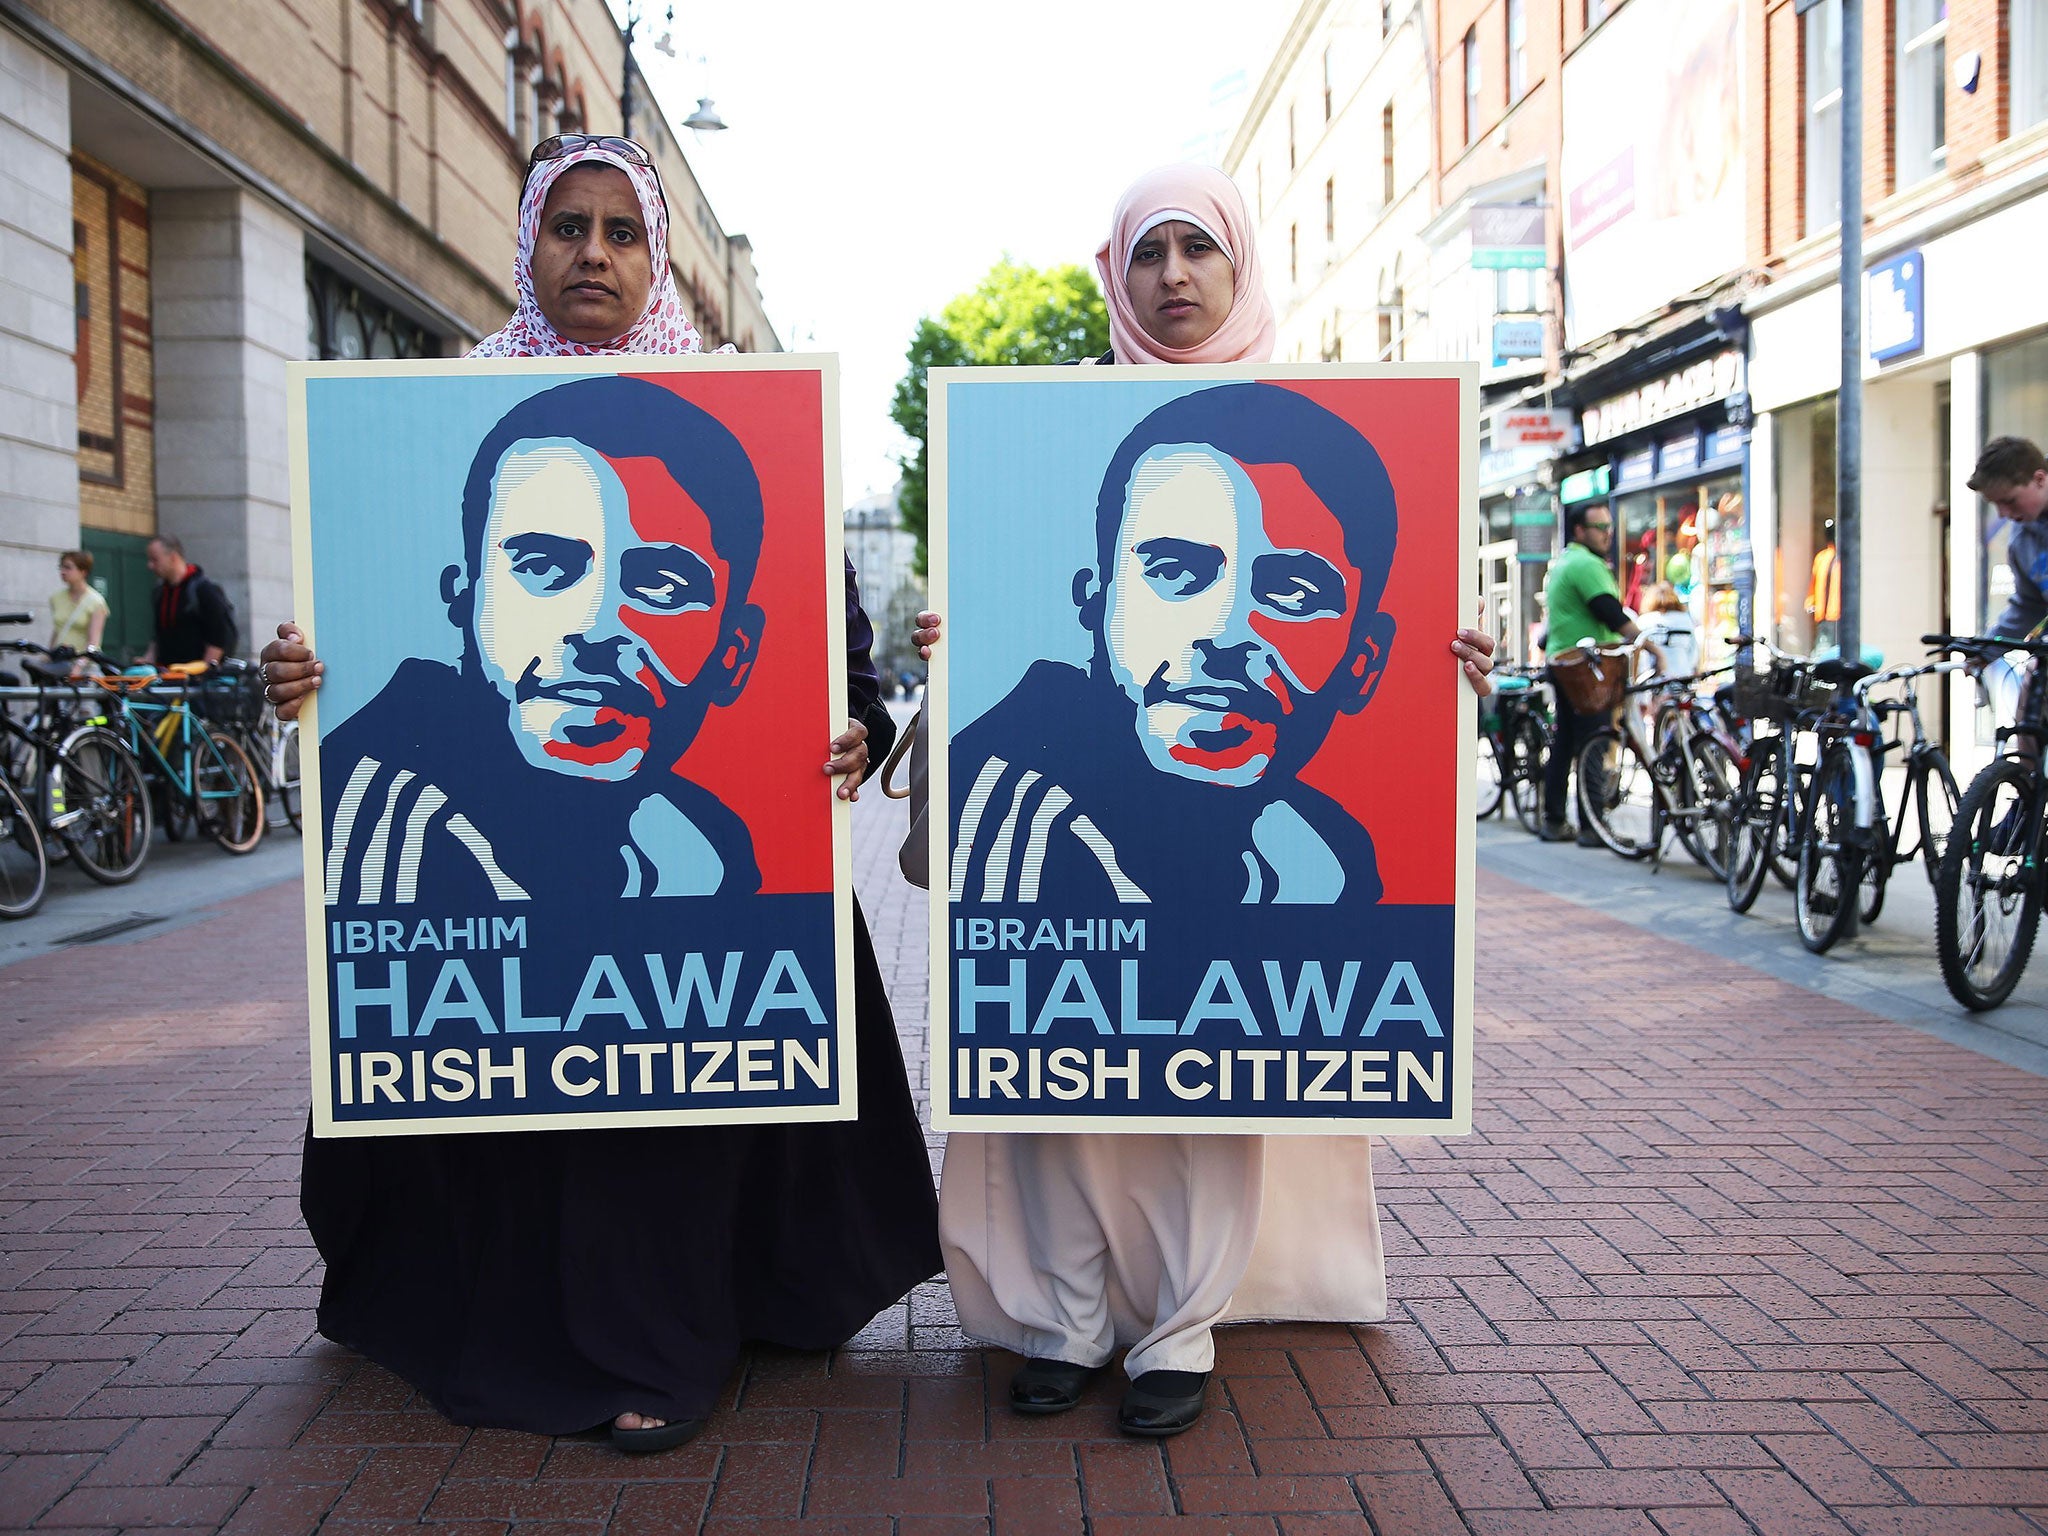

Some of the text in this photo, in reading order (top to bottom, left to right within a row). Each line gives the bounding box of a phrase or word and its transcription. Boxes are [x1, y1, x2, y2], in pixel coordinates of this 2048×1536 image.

[332, 916, 528, 954] IBRAHIM
[954, 918, 1146, 952] IBRAHIM
[336, 950, 829, 1039] HALAWA
[957, 958, 1445, 1038] HALAWA
[338, 1037, 831, 1105] IRISH CITIZEN
[956, 1047, 1444, 1103] IRISH CITIZEN
